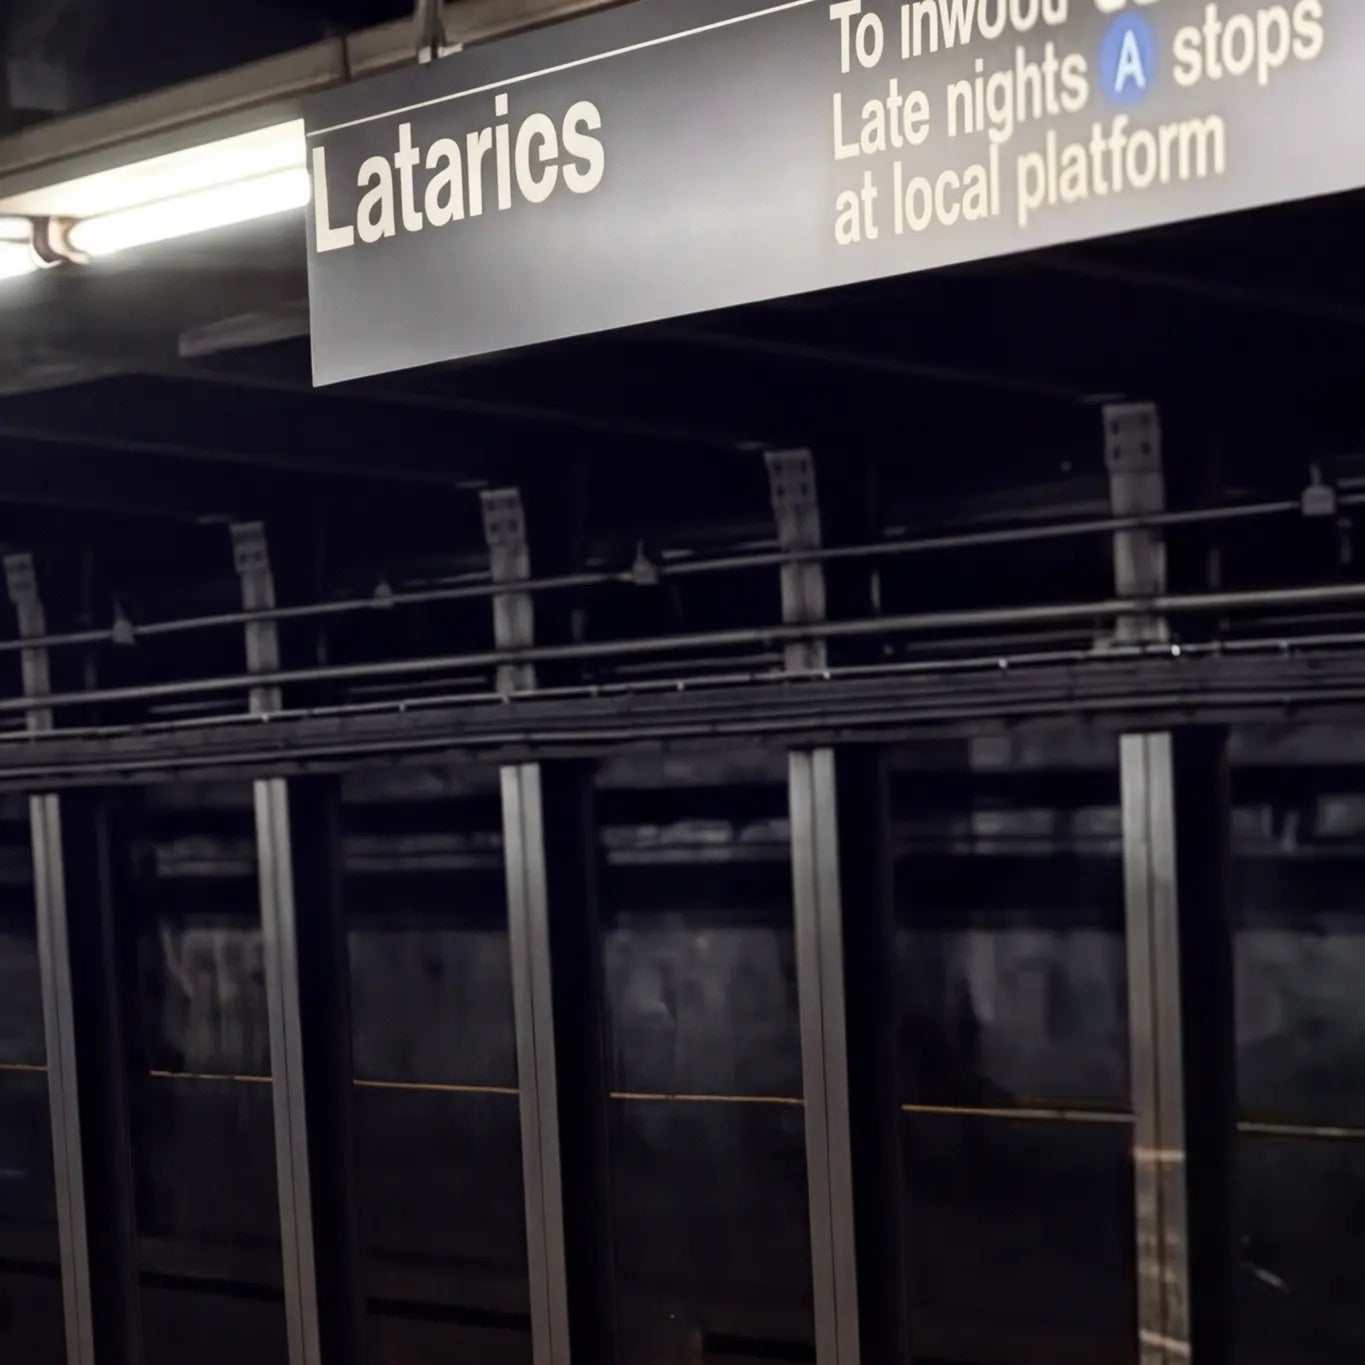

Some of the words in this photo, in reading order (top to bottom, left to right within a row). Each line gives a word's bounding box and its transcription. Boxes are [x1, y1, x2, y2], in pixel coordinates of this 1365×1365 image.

[829, 0, 884, 73] To
[833, 78, 930, 160] Late
[947, 41, 1090, 143] nights
[1113, 28, 1147, 93] A
[1173, 0, 1323, 86] stops
[834, 170, 879, 246] at
[893, 144, 1000, 236] local
[1017, 113, 1225, 228] platform
